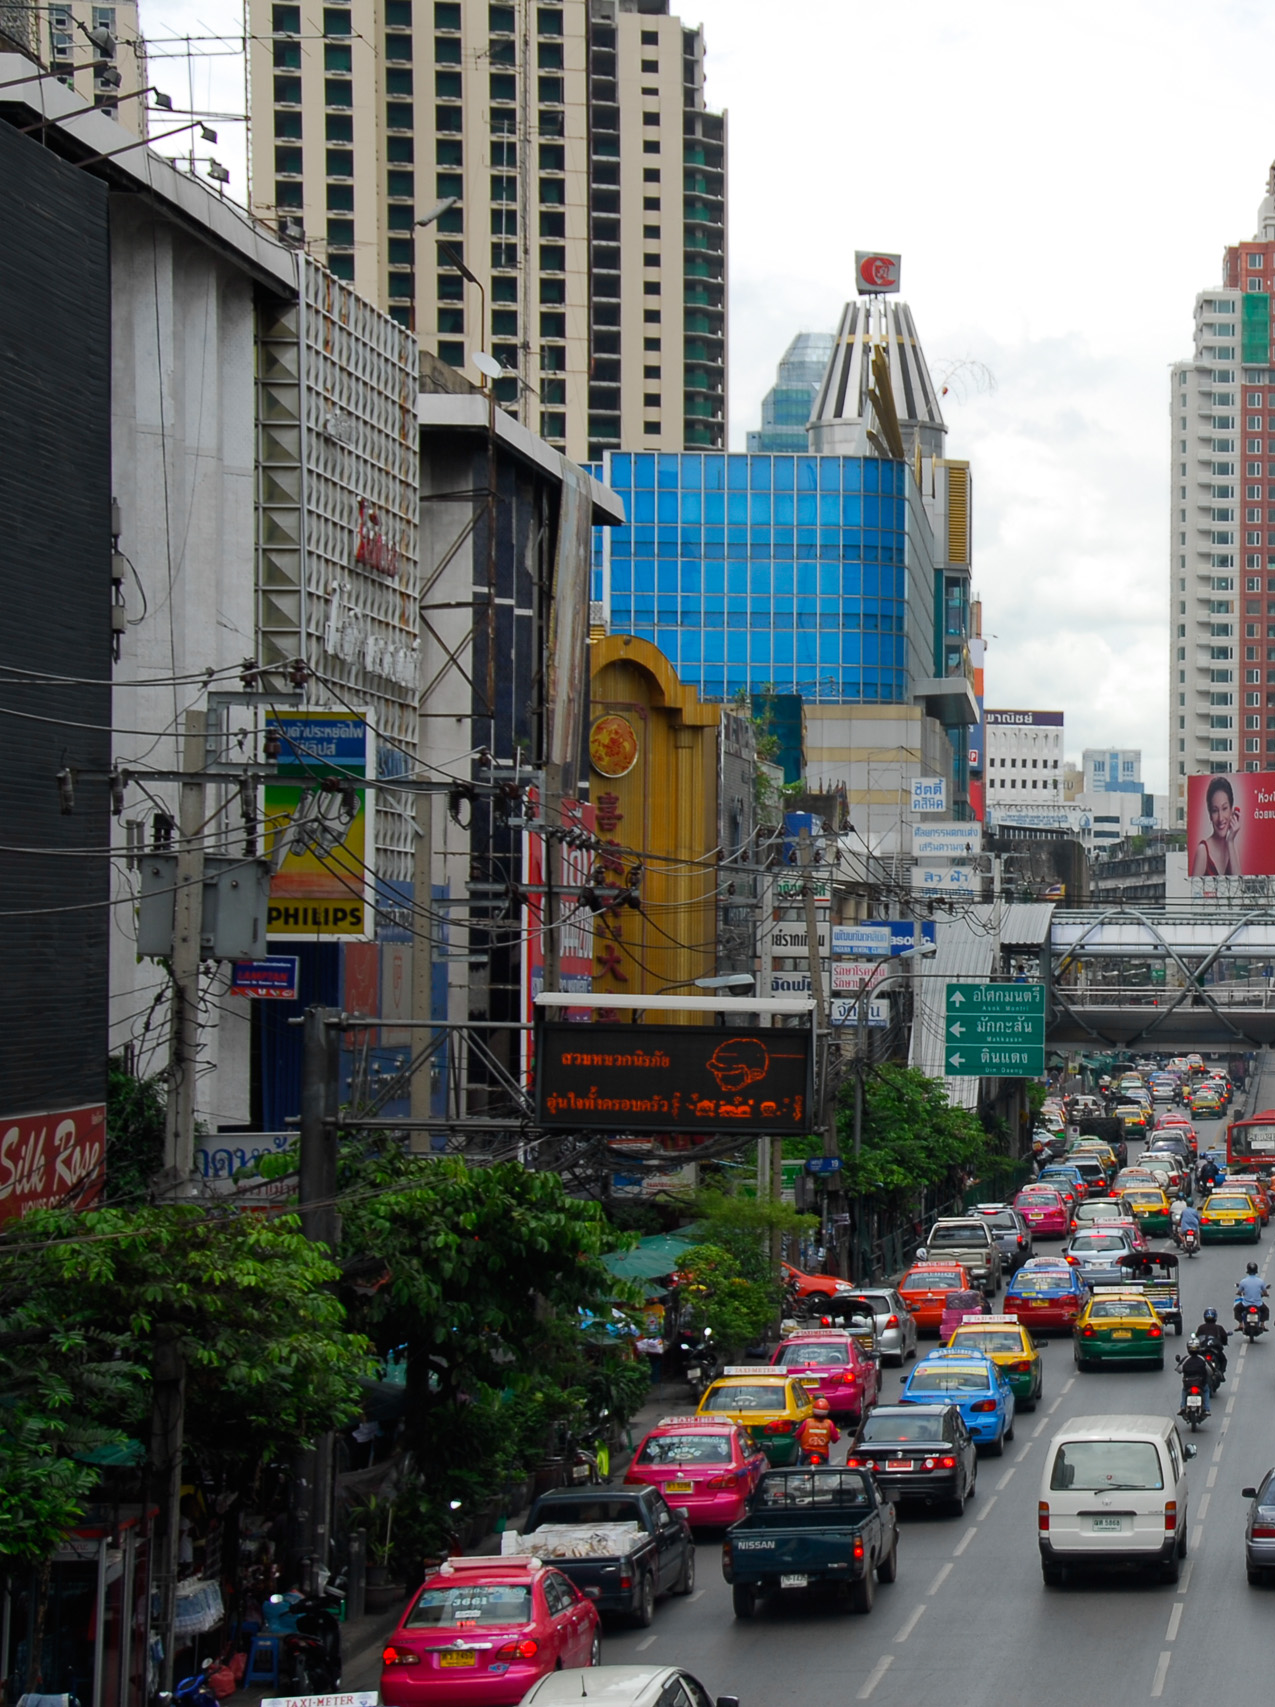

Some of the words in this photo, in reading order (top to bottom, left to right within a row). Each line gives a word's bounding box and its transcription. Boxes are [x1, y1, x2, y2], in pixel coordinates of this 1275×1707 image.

[268, 907, 361, 926] PHILIPS
[973, 985, 1040, 1002] อโศกมนตรี
[976, 1016, 1032, 1032] มักกะสัน
[561, 1050, 670, 1067] สวมหมวกนิรภัย
[980, 1047, 1028, 1064] ดินแดง
[0, 1126, 48, 1199] Silk
[738, 1540, 775, 1549] NISSAN
